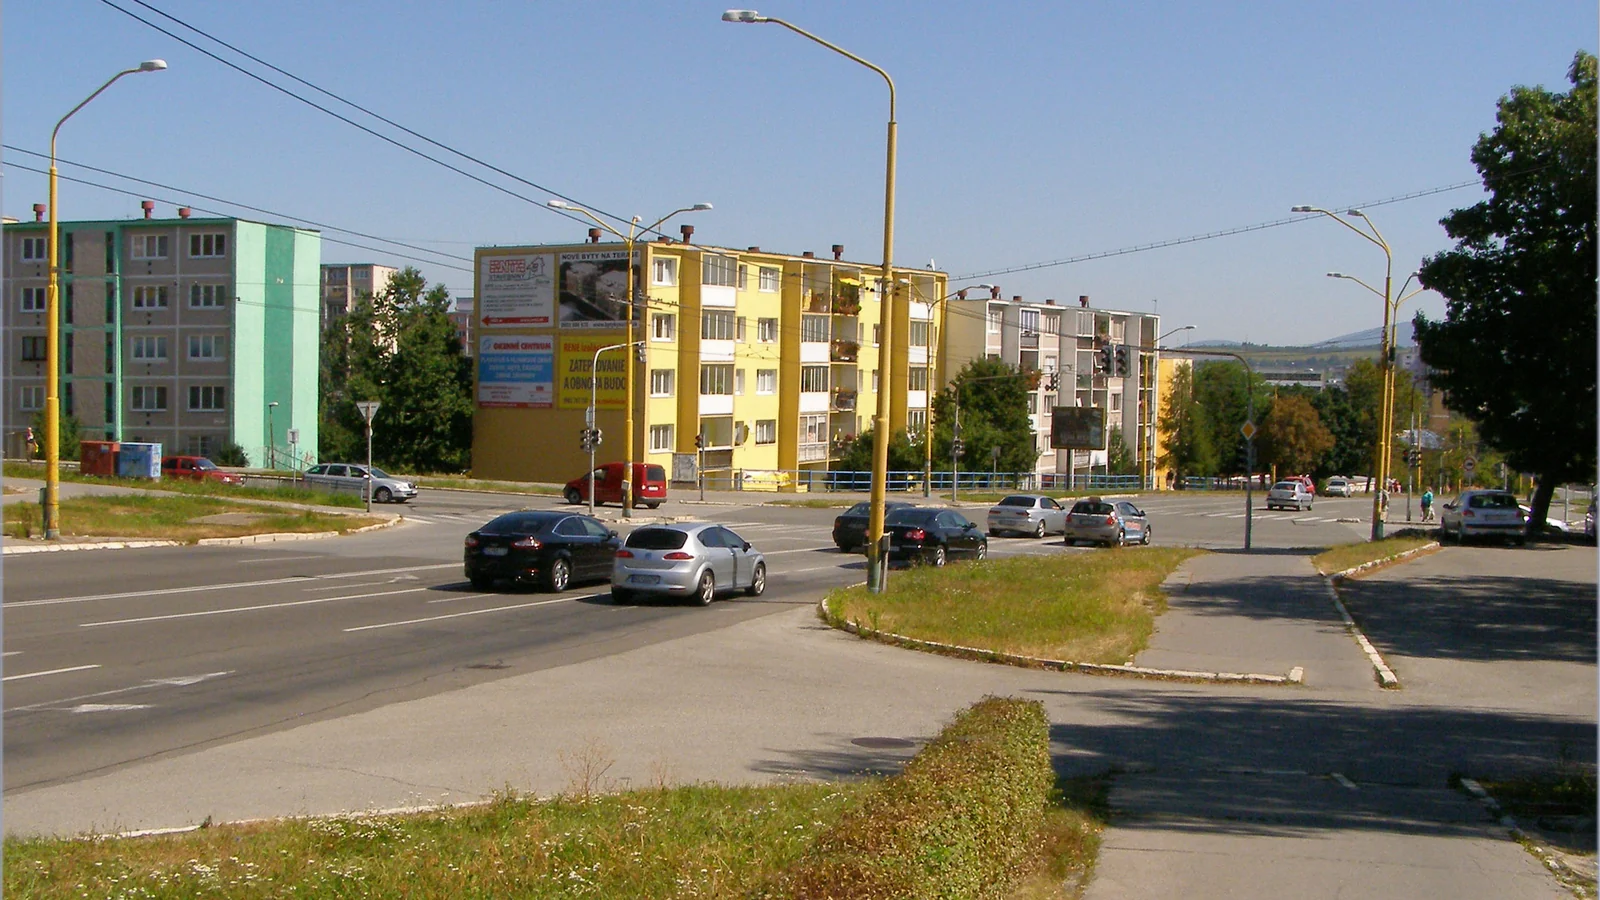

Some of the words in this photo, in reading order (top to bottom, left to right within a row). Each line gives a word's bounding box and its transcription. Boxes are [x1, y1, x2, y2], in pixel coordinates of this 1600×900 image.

[521, 342, 552, 350] CENTRUM
[569, 359, 626, 373] ZATEPOVANIE
[564, 377, 570, 389] A
[604, 376, 627, 390] BUDO
